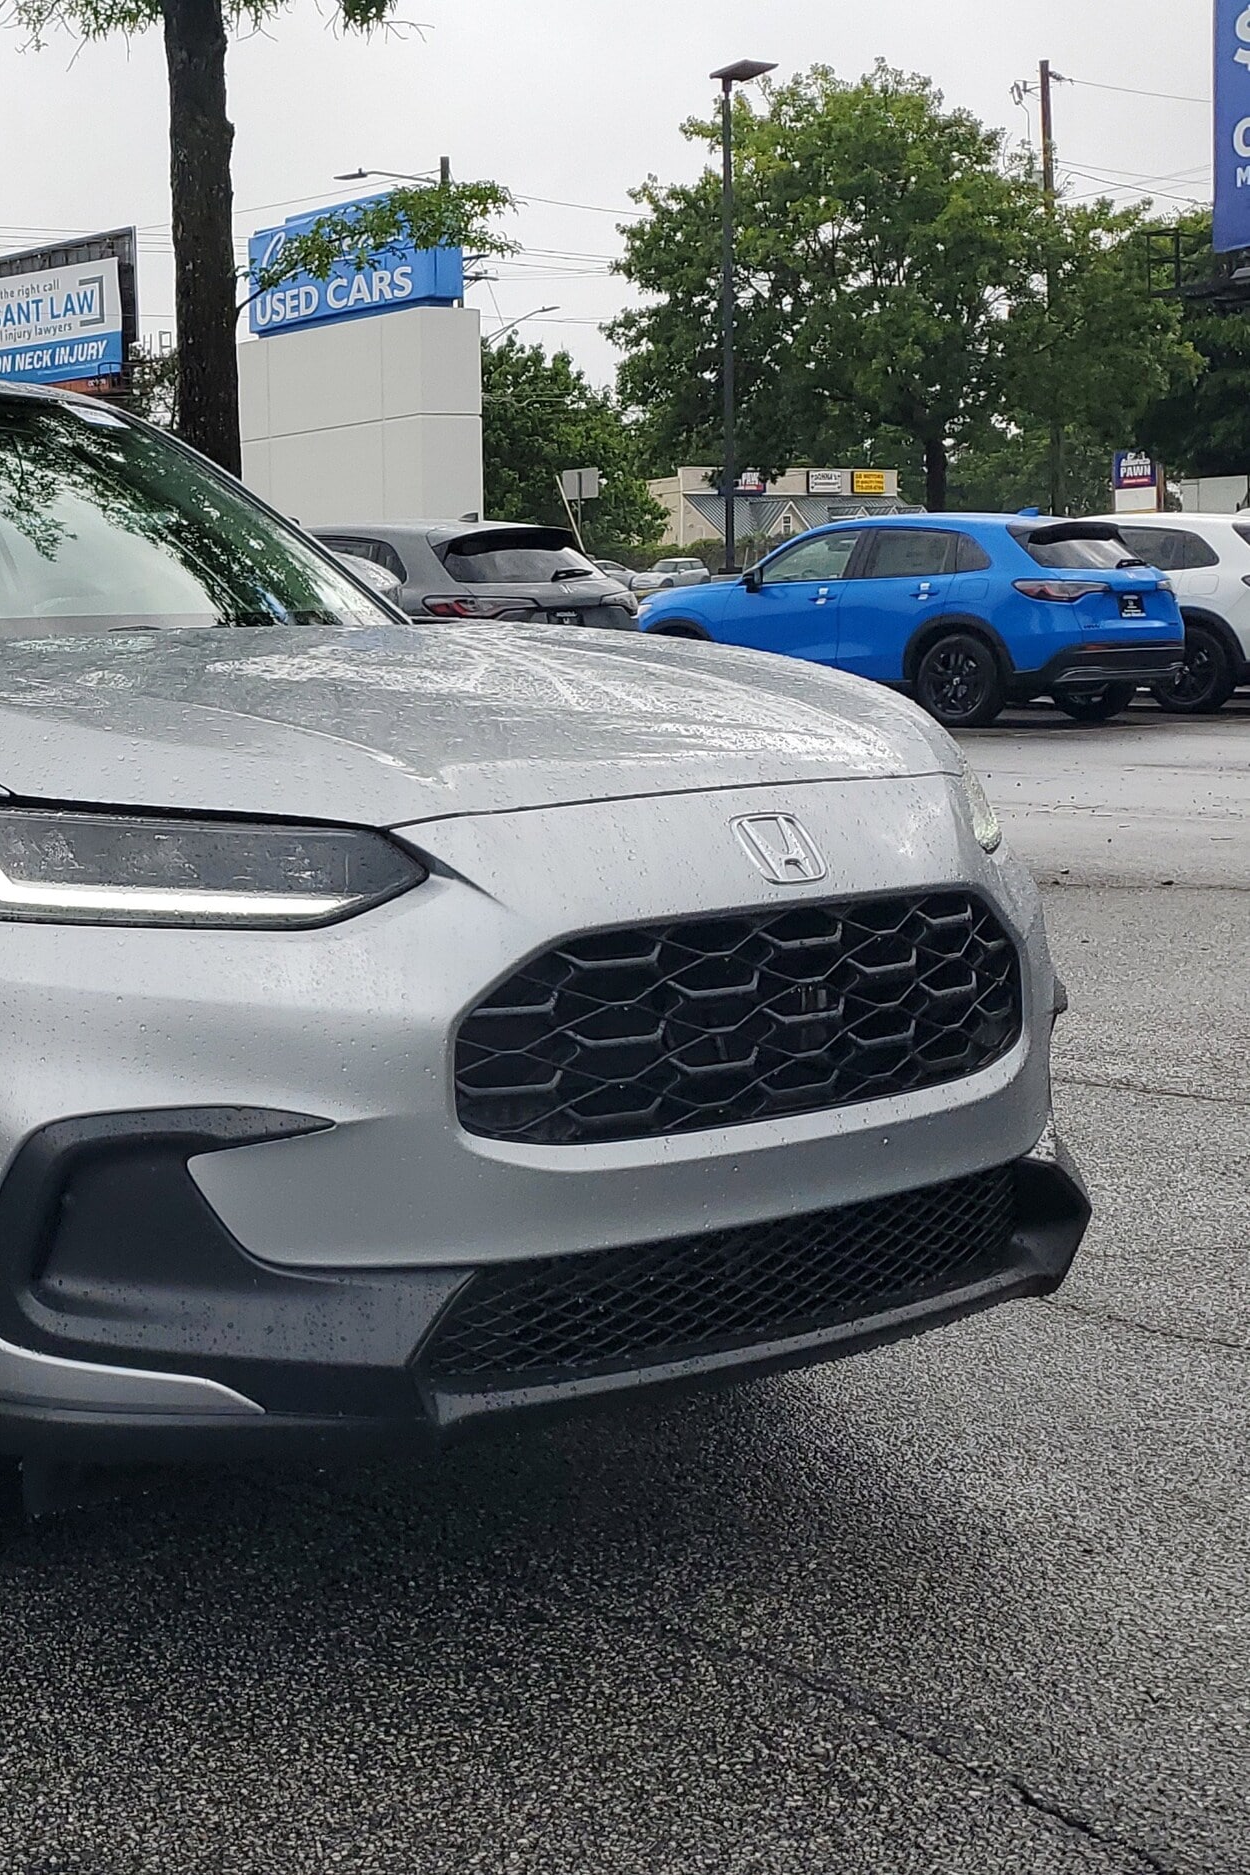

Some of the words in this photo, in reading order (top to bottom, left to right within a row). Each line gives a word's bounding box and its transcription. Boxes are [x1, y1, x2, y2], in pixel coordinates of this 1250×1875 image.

[0, 288, 15, 300] the
[18, 285, 40, 298] right
[43, 278, 60, 292] call
[255, 285, 319, 326] USED
[327, 266, 413, 309] CARS
[50, 289, 94, 320] LAW
[5, 328, 32, 342] injury
[35, 323, 72, 336] lawyers
[14, 348, 53, 372] NECK
[54, 339, 108, 366] INJURY
[1120, 464, 1151, 478] PAWN
